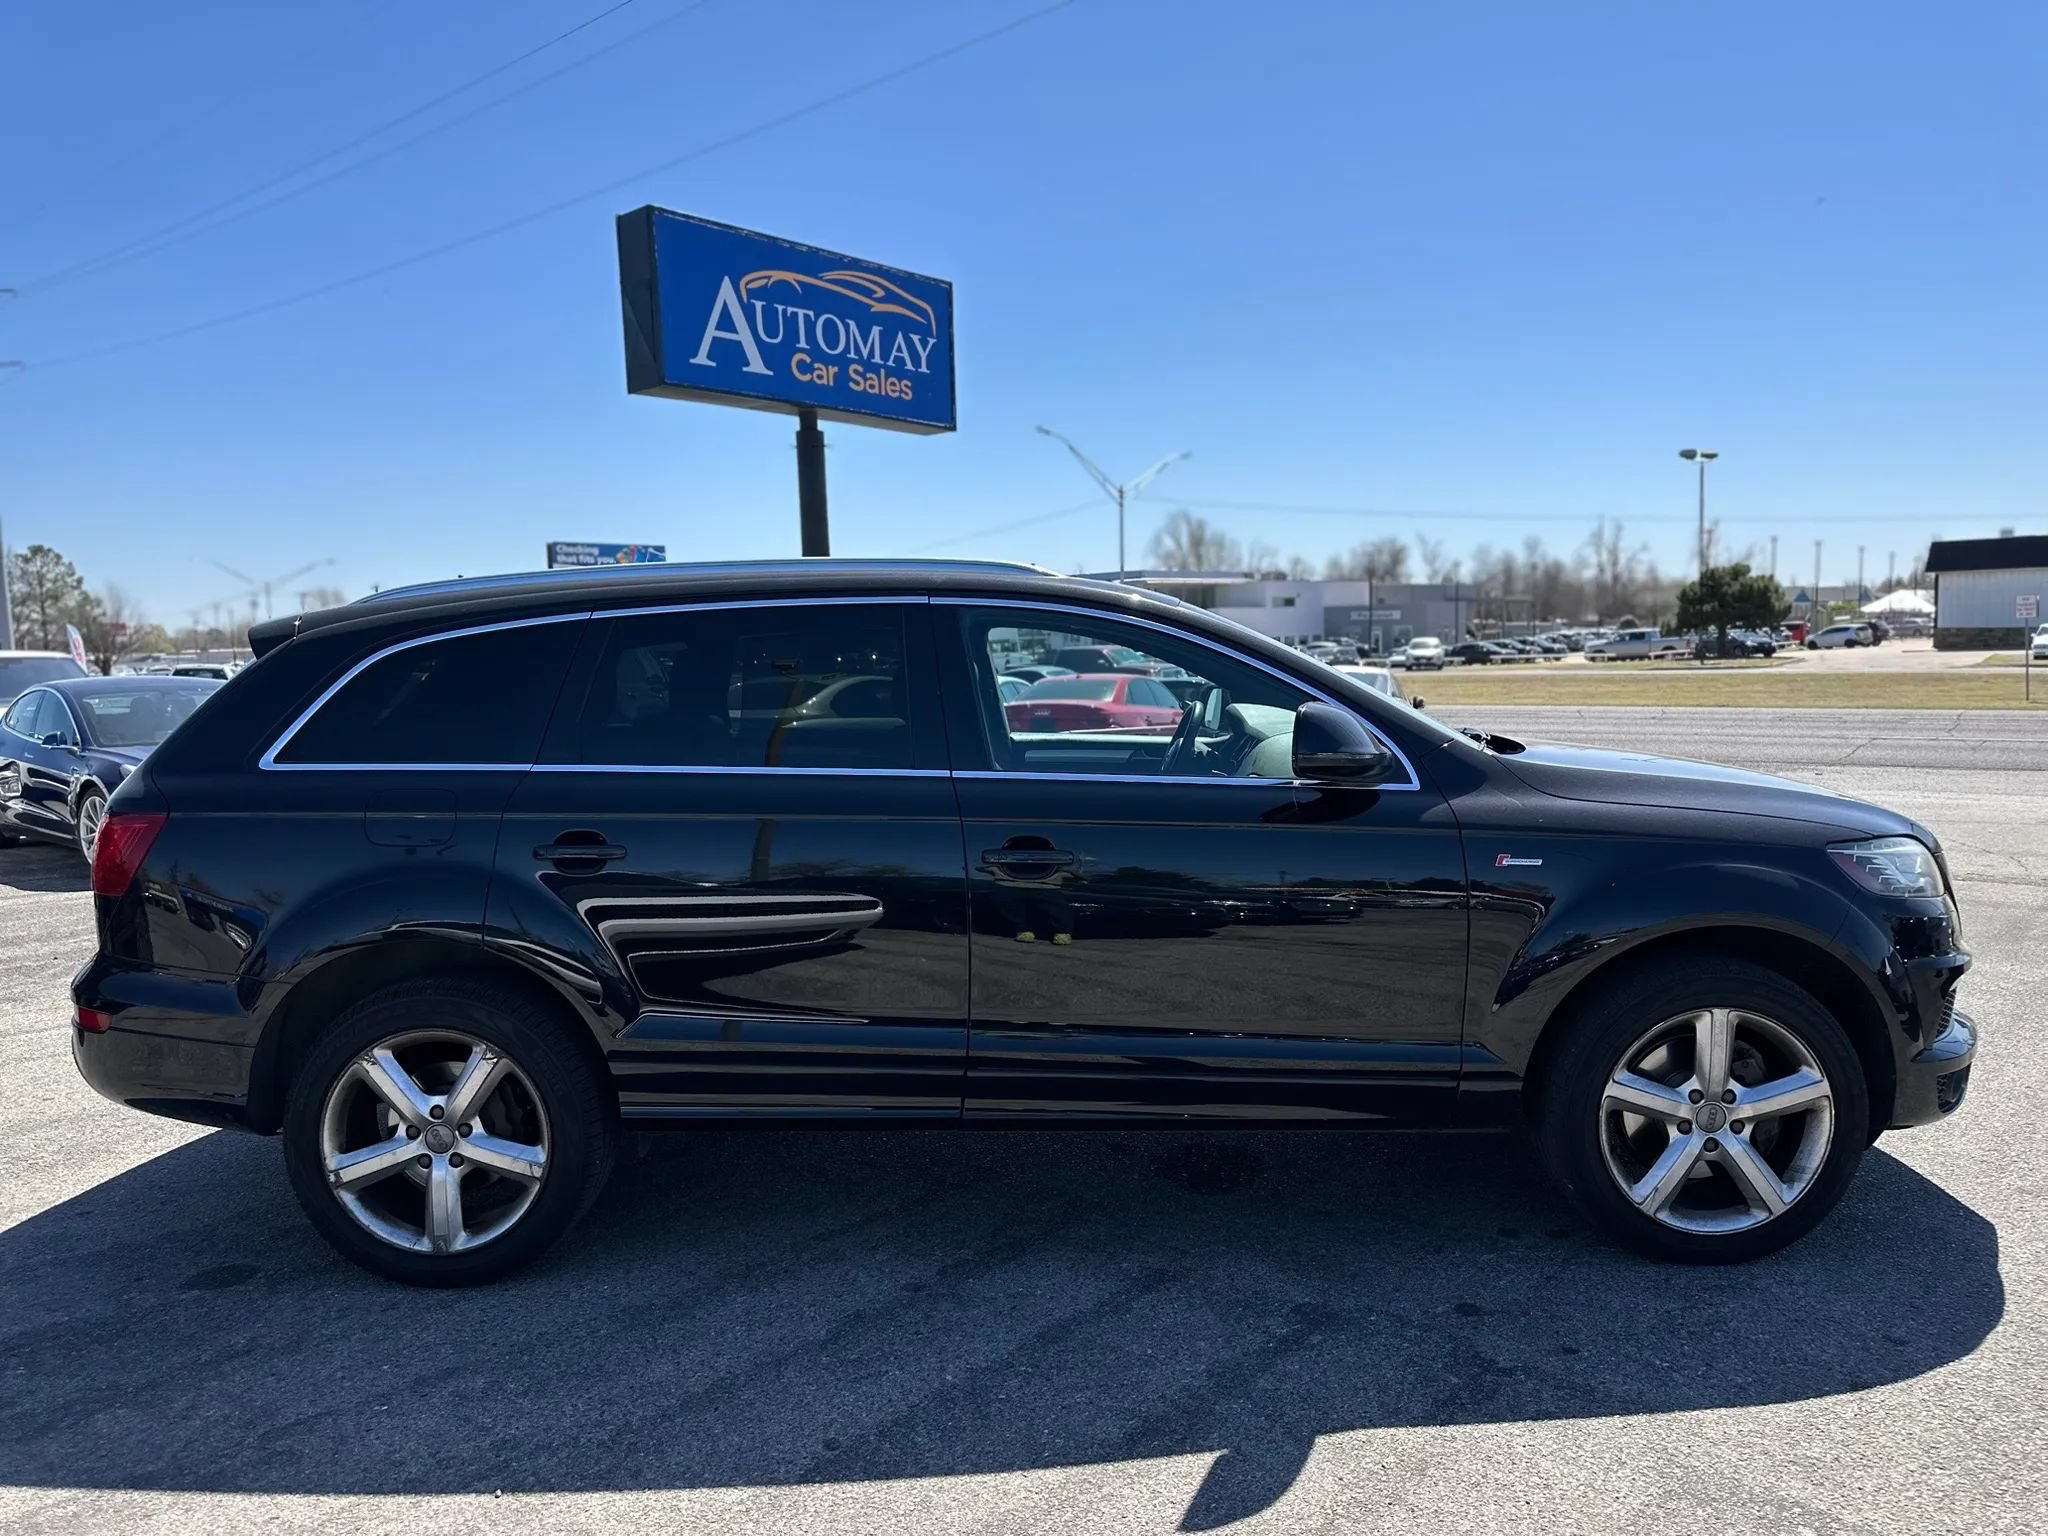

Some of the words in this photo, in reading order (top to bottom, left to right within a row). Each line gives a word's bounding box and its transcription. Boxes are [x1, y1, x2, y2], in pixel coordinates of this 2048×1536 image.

[689, 275, 937, 376] AUTOMAY
[790, 352, 839, 387] Car
[848, 363, 913, 401] Sales
